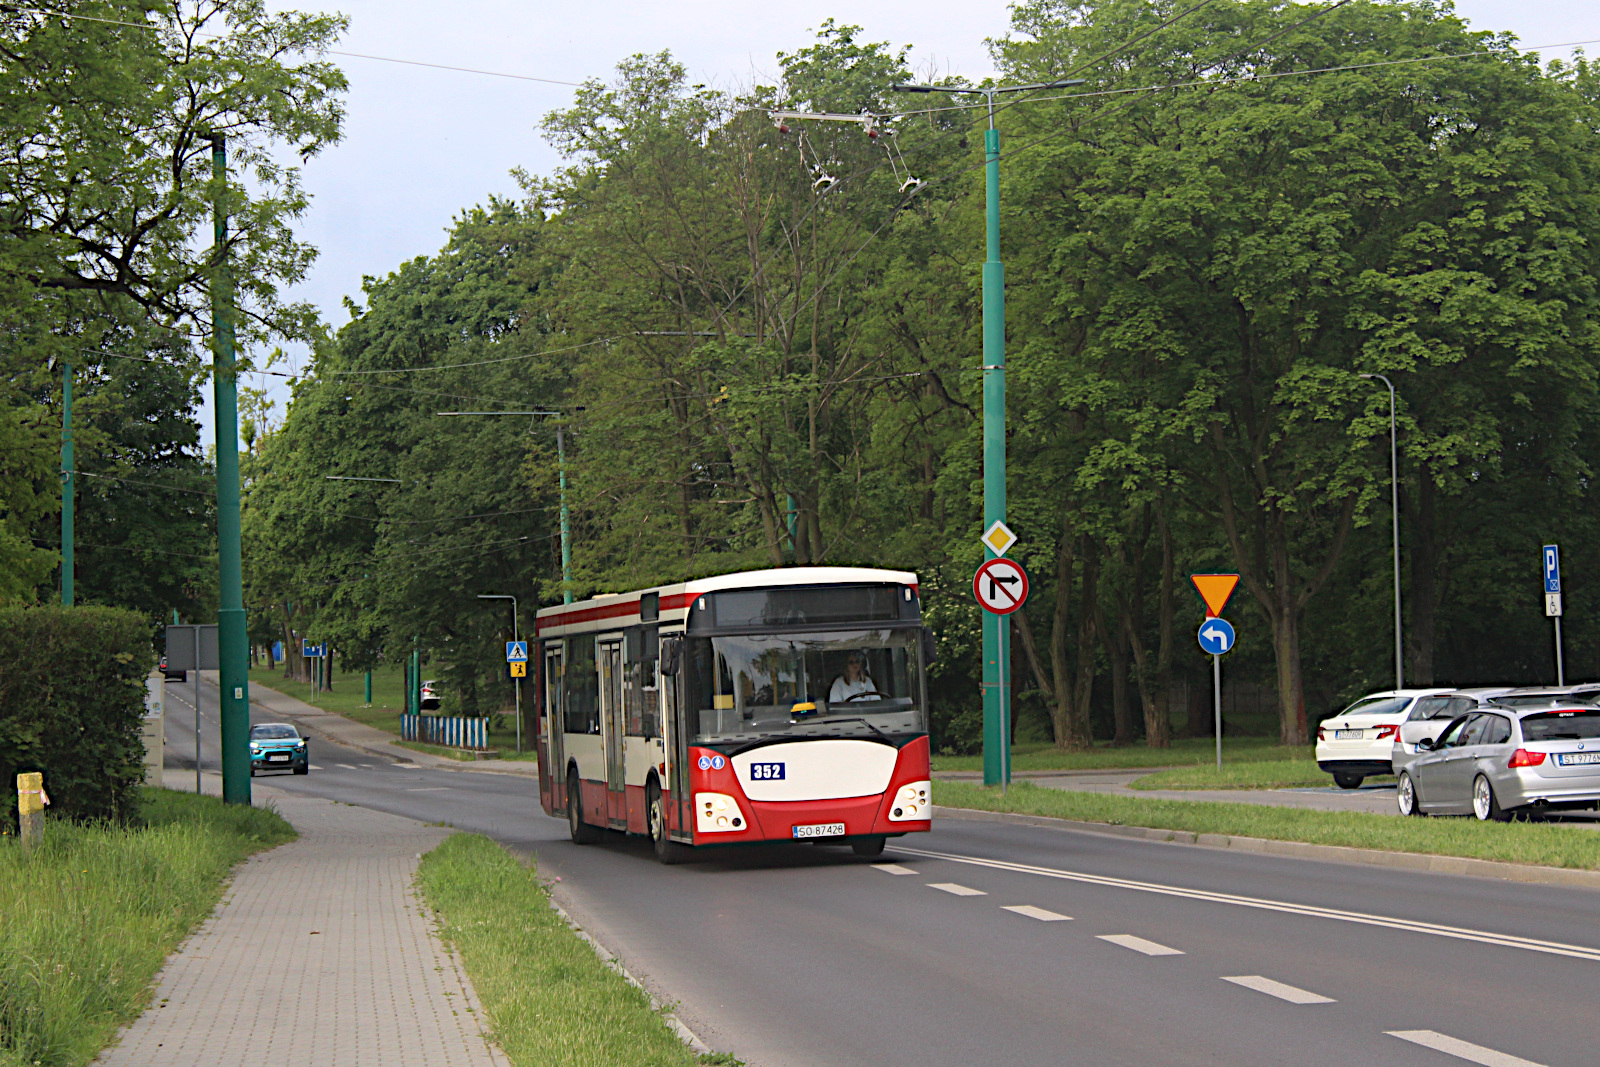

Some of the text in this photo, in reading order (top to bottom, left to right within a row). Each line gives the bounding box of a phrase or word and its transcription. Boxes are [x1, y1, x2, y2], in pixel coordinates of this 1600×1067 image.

[1546, 550, 1555, 579] P
[1564, 755, 1575, 764] ST
[754, 765, 780, 778] 352
[798, 824, 843, 837] SO 87428
